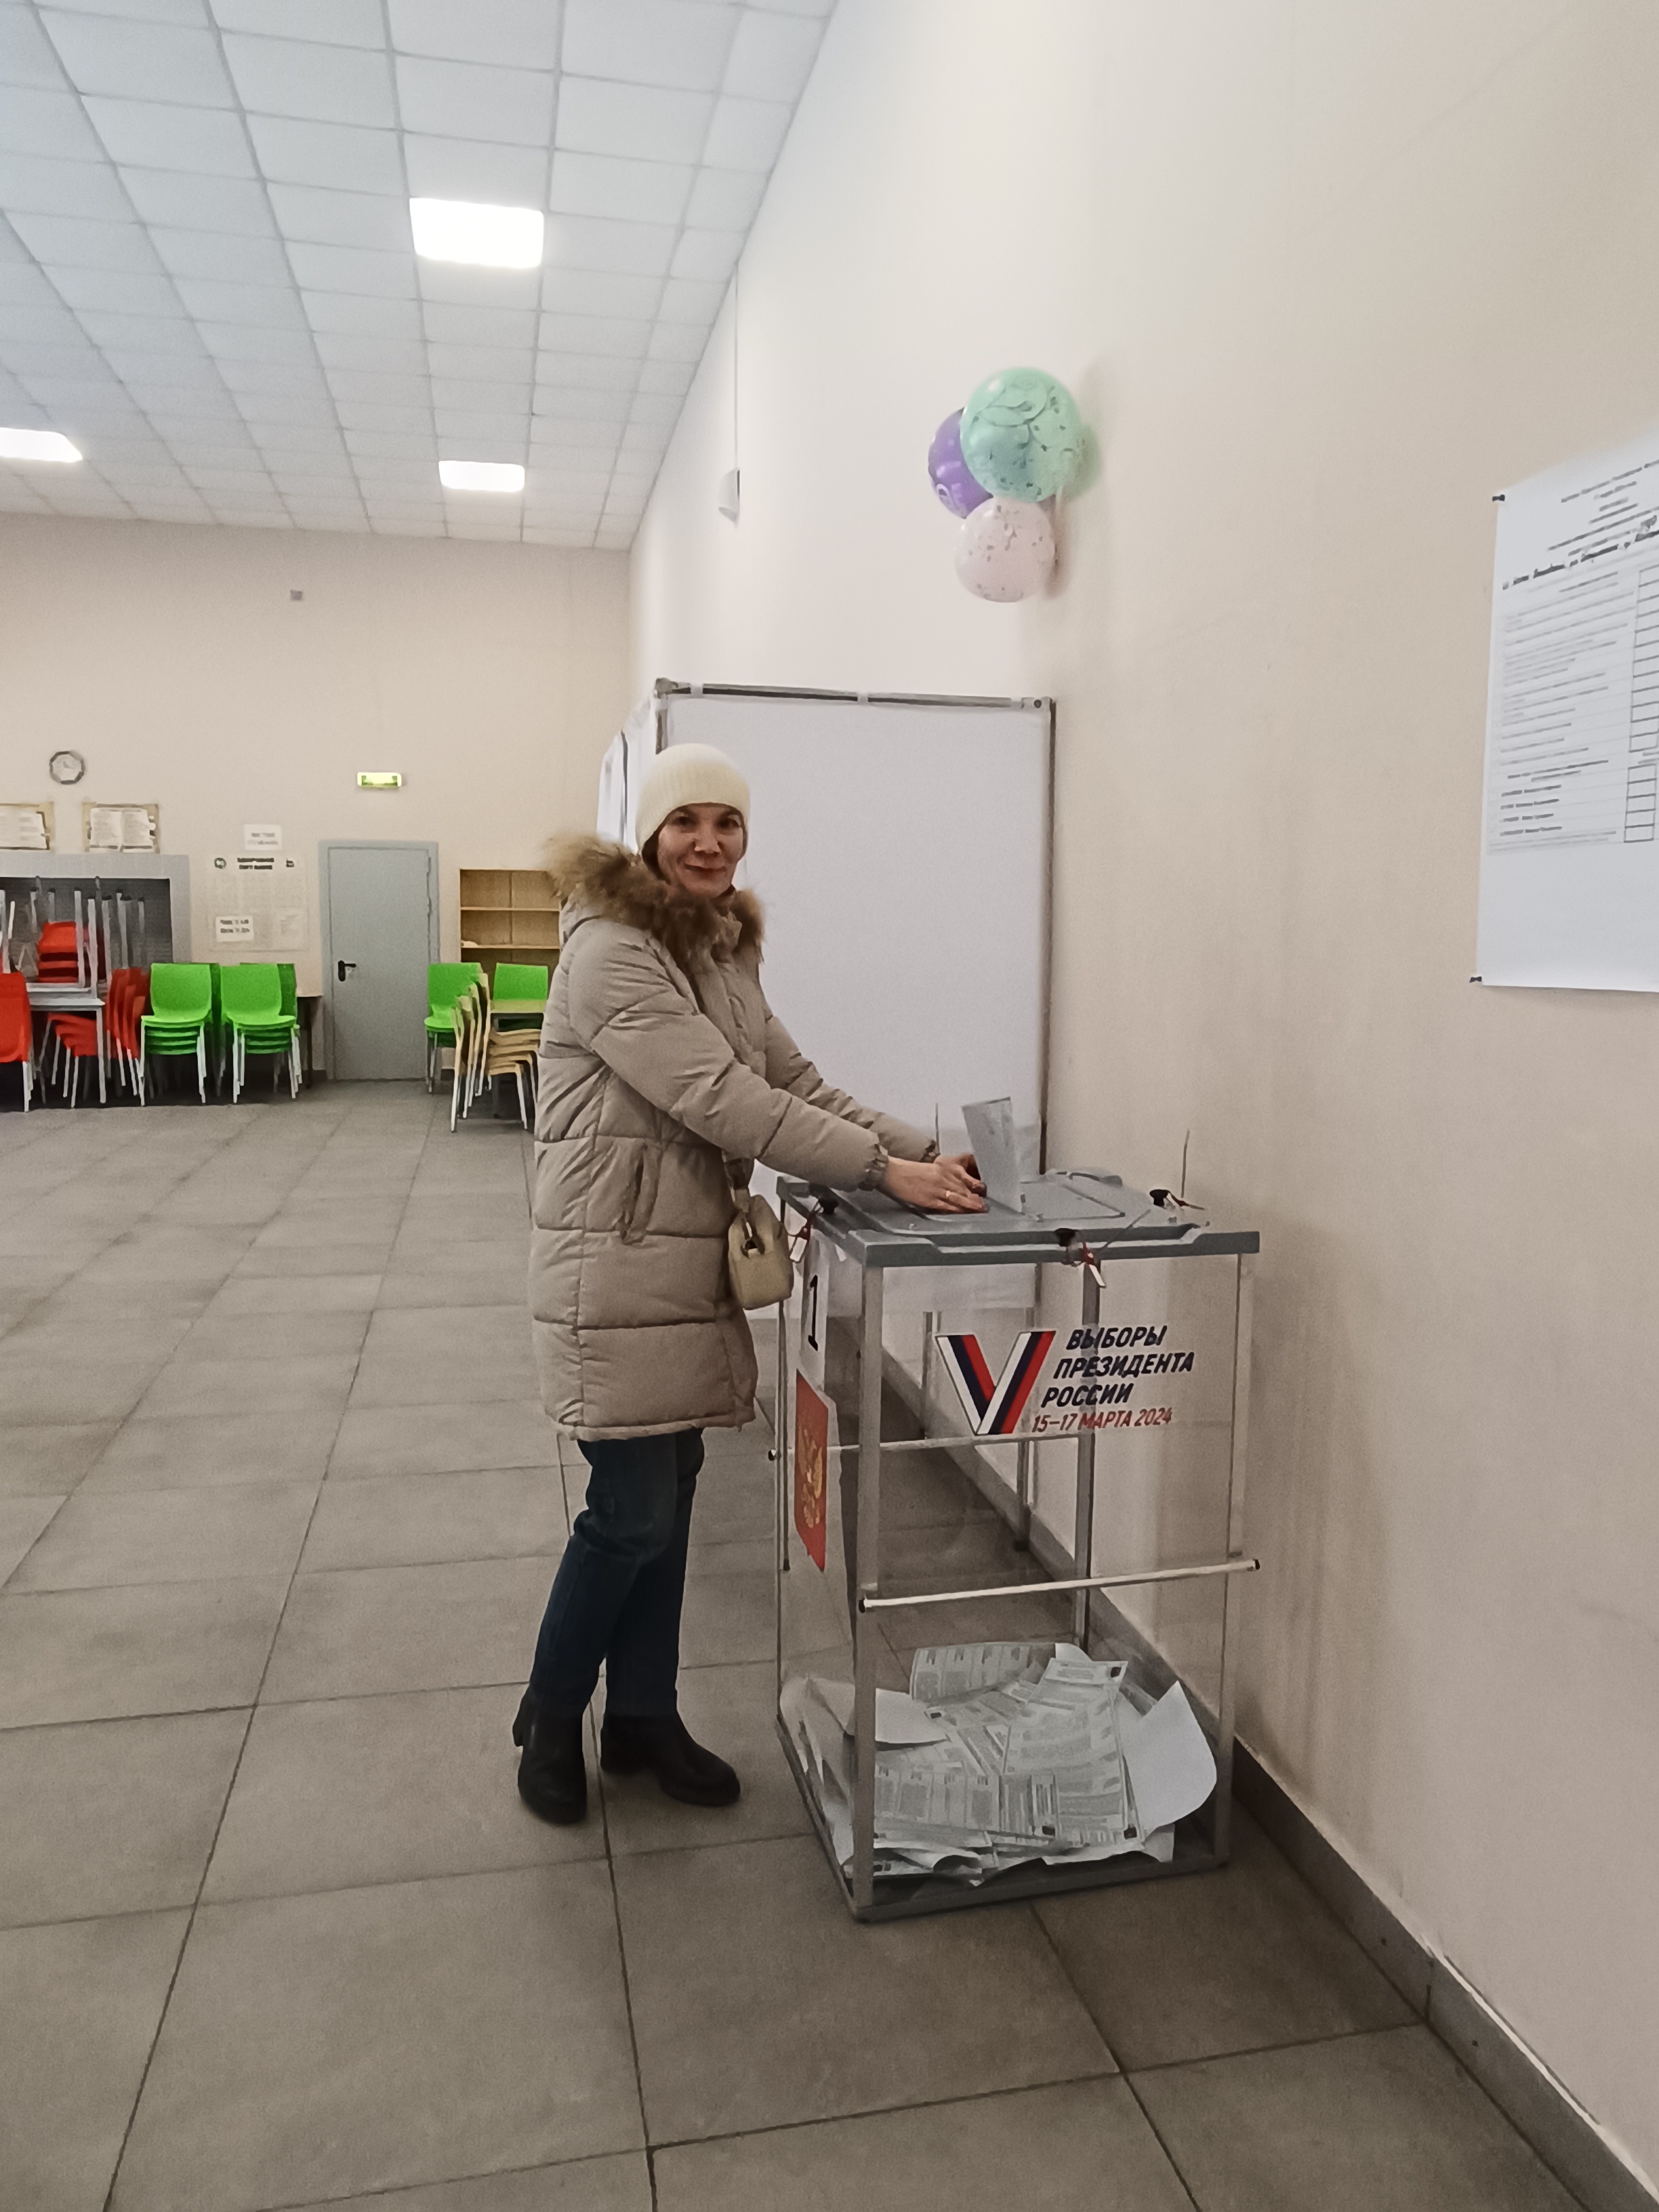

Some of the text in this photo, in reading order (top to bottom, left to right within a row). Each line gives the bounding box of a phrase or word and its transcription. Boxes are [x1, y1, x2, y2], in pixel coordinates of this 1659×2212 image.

[1066, 1326, 1167, 1350] ВЫБОРЫ
[1053, 1352, 1195, 1379] ПРЕЗИДЕНТА
[1041, 1382, 1134, 1408] РОССИИ
[1078, 1408, 1131, 1431] МАРТА
[1134, 1407, 1173, 1427] 2024
